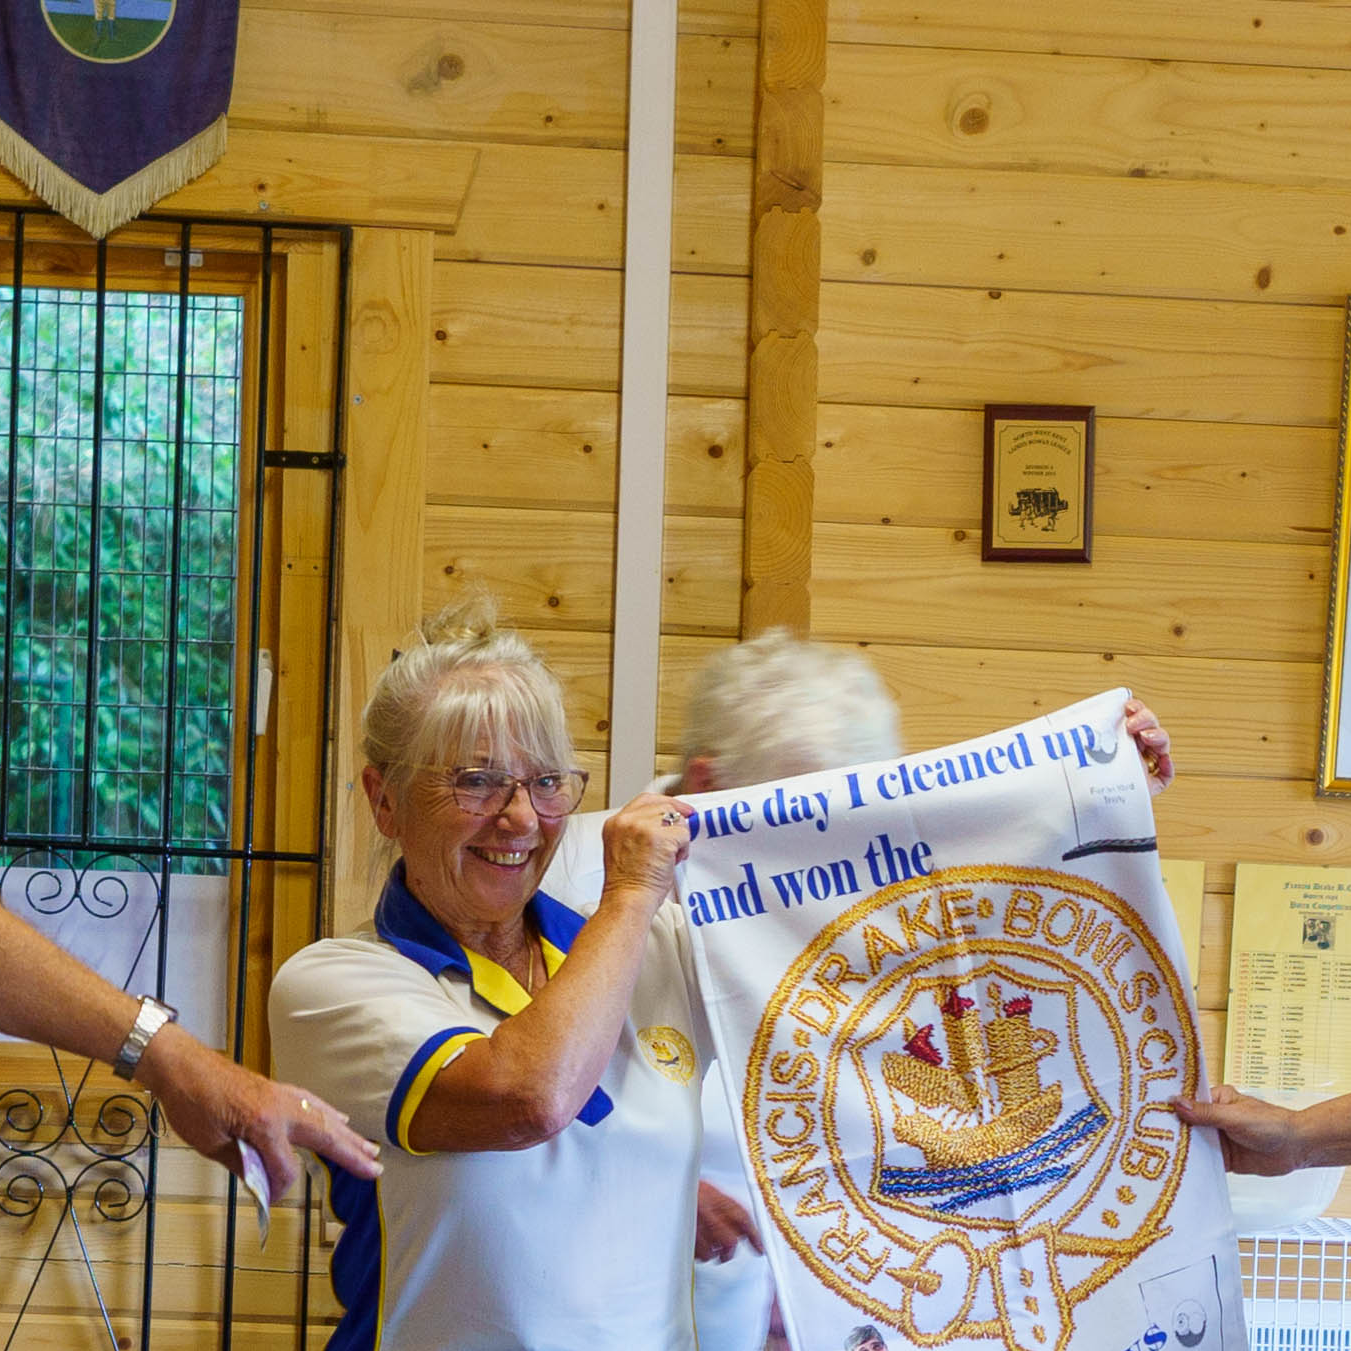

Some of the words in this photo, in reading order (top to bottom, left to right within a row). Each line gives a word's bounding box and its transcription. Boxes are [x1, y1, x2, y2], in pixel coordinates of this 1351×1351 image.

[762, 788, 832, 832] day
[844, 773, 868, 809] I
[876, 732, 1036, 800] cleaned
[1041, 724, 1096, 769] up
[688, 862, 768, 927] and
[769, 858, 862, 909] won
[864, 833, 935, 888] the
[789, 889, 977, 1036] DRAKE
[1002, 889, 1161, 1014] BOWLS
[764, 1049, 892, 1284] FRANCIS
[1120, 1028, 1180, 1182] CLUB
